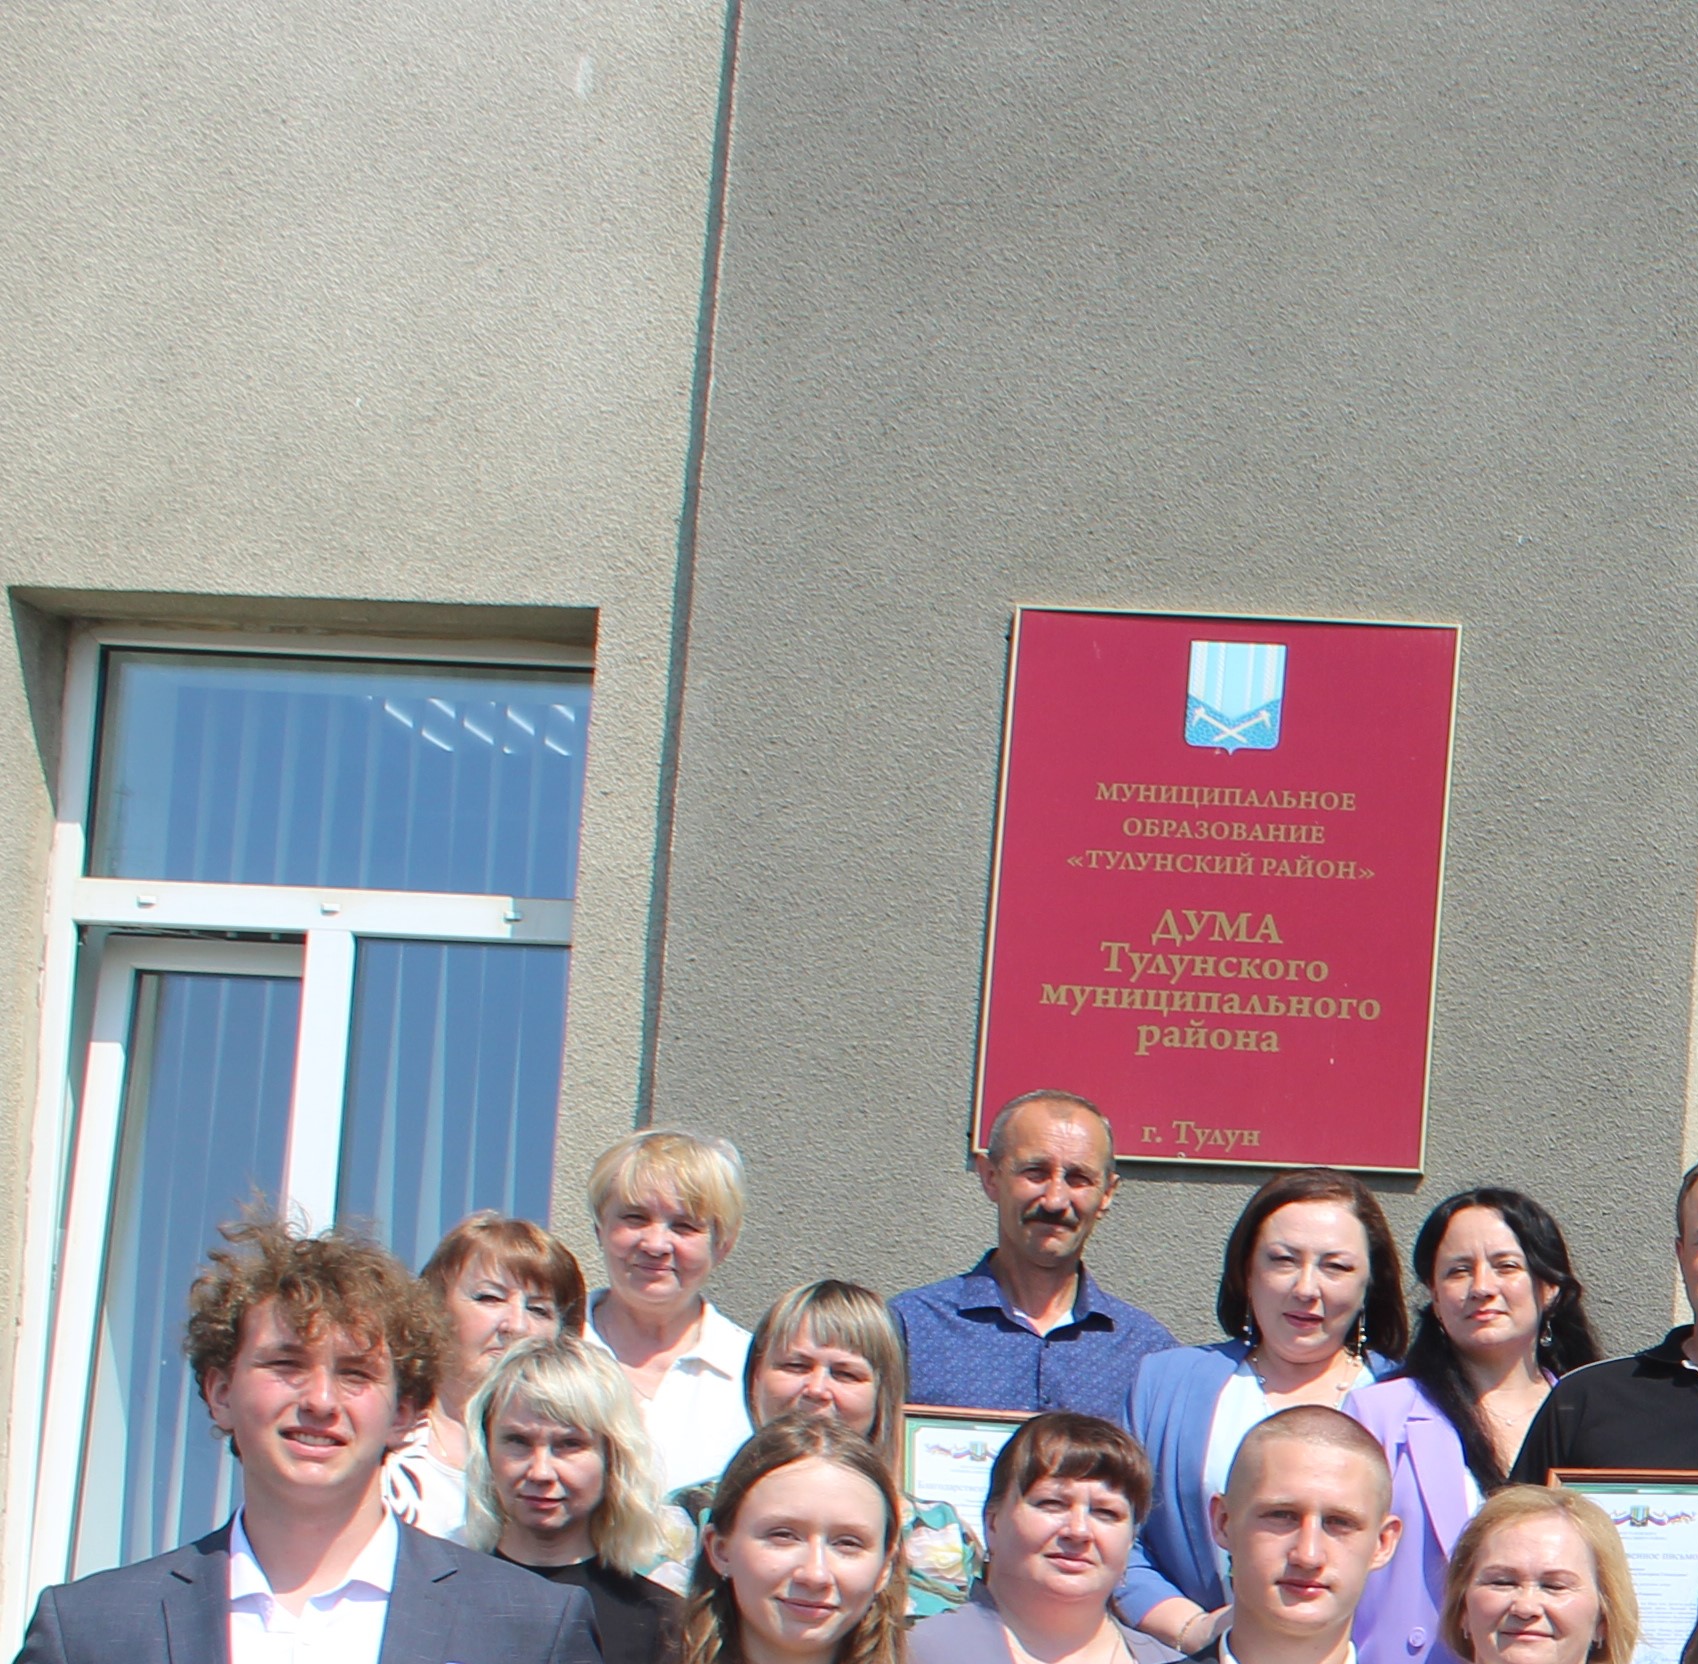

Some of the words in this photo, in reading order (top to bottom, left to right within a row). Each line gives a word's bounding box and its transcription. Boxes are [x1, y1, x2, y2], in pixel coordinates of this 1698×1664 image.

[1095, 782, 1356, 811] МУНИЦИПАЛЬНОЕ
[1123, 818, 1325, 844] ОБРАЗОВАНИЕ
[1067, 850, 1255, 875] «ТУЛУНСКИЙ
[1260, 854, 1375, 880] РАЙОН»
[1151, 909, 1284, 947] ДУМА
[1100, 941, 1328, 985] Тулунского
[1039, 983, 1381, 1020] муниципального
[1134, 1019, 1280, 1056] района
[1141, 1126, 1162, 1143] г.
[1172, 1120, 1261, 1153] Тулун
